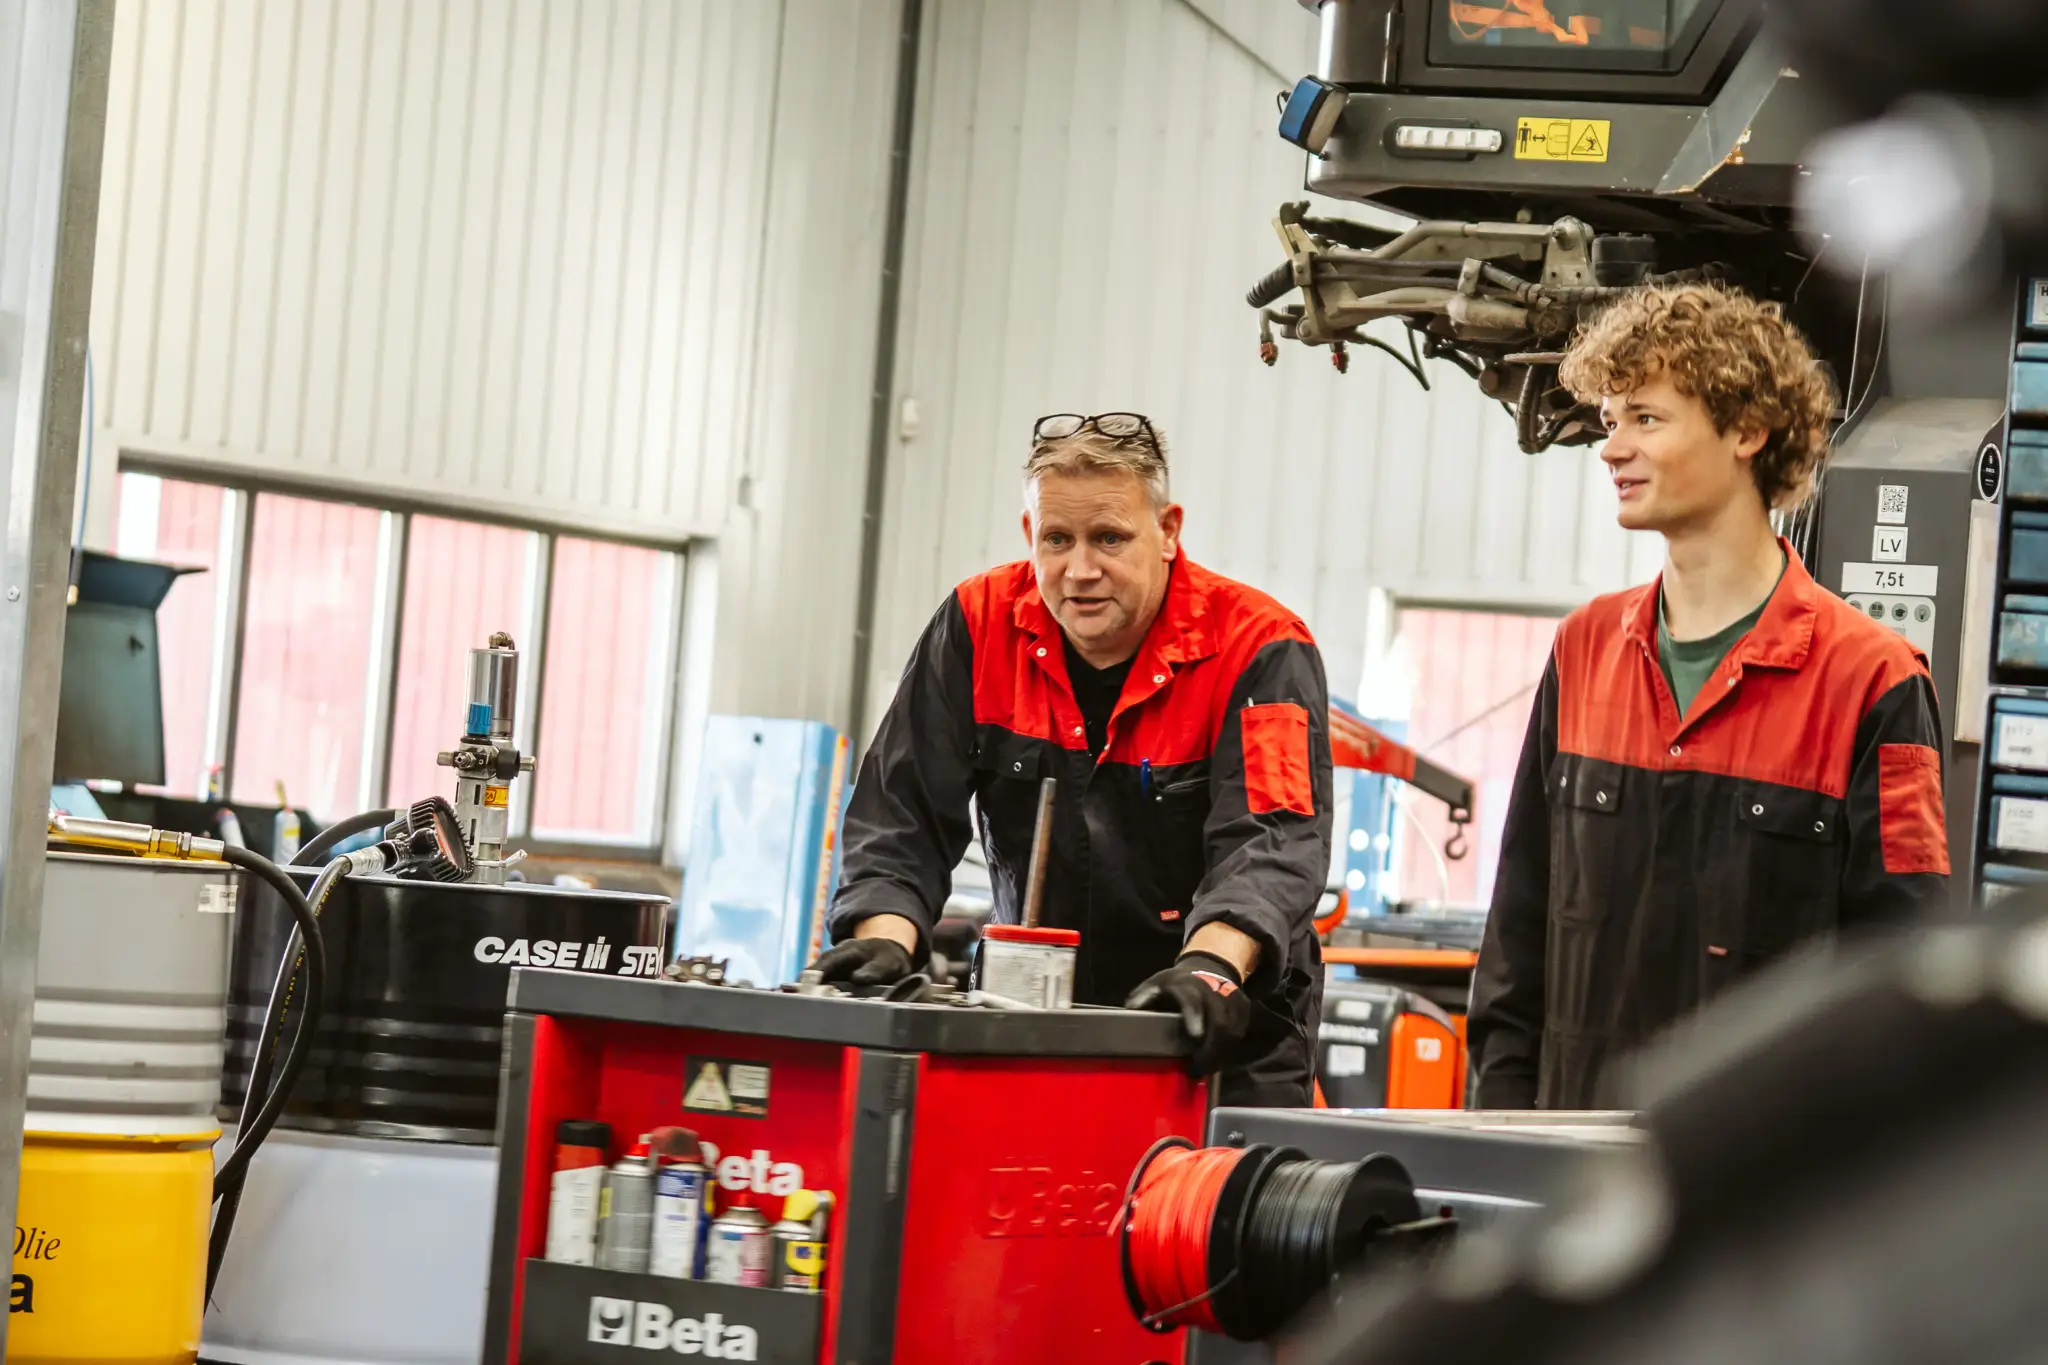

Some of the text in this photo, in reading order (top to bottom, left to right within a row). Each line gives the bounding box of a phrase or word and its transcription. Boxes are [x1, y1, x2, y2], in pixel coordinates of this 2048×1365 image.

[1880, 538, 1902, 553] LV
[474, 936, 582, 968] CASE
[632, 1301, 759, 1362] Beta
